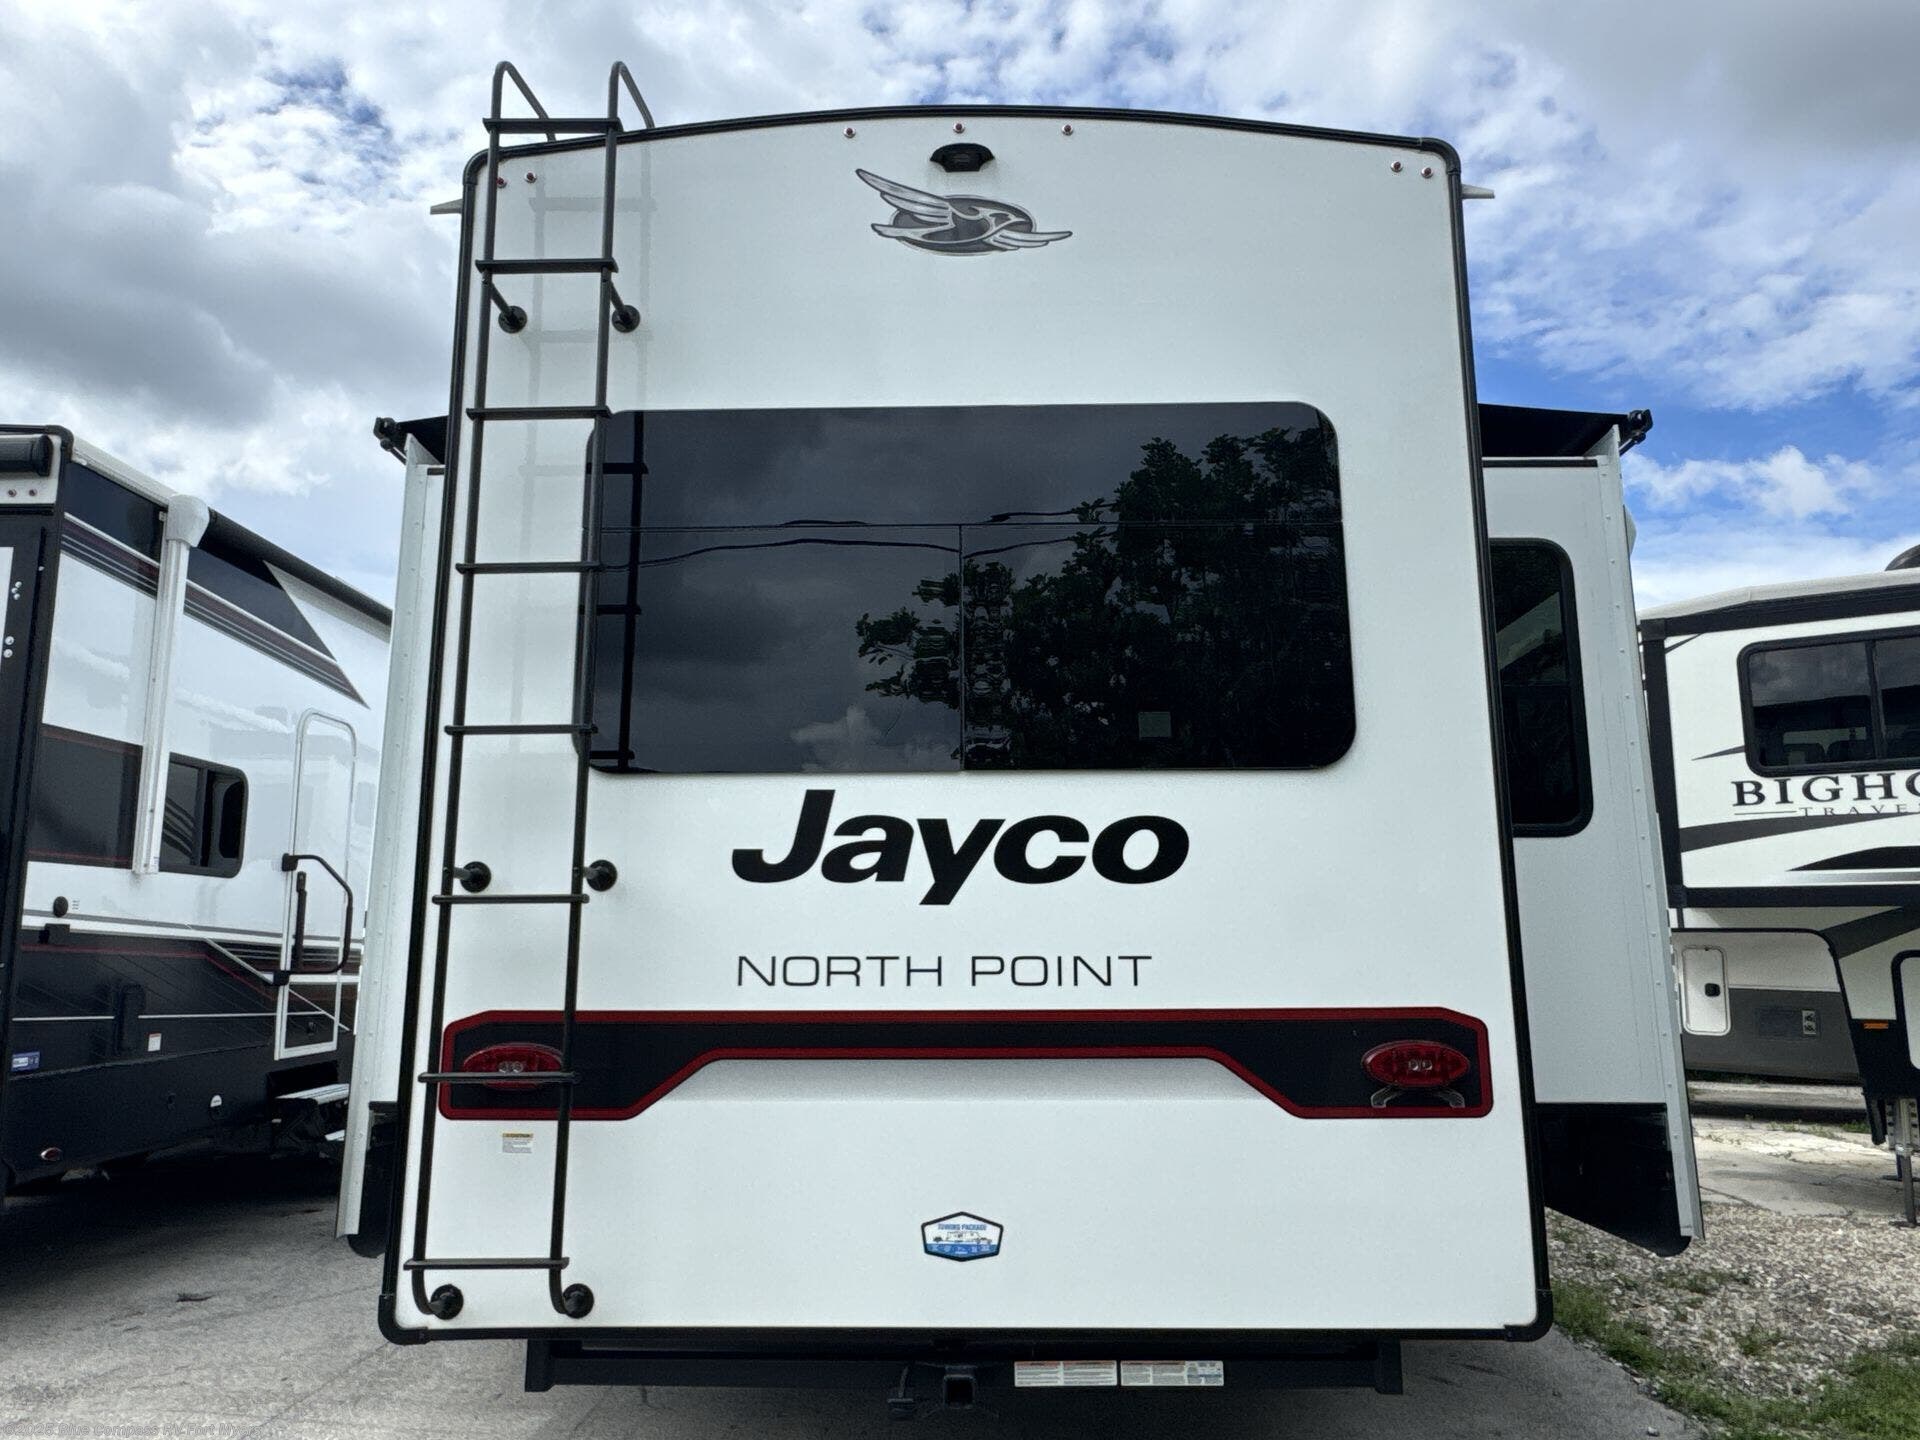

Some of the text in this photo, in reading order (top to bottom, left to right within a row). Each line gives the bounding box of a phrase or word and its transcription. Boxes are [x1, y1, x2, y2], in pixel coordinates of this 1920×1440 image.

[1799, 803, 1920, 817] TRAVE
[731, 789, 1190, 906] Jayco
[737, 956, 1152, 987] NORTH POINT
